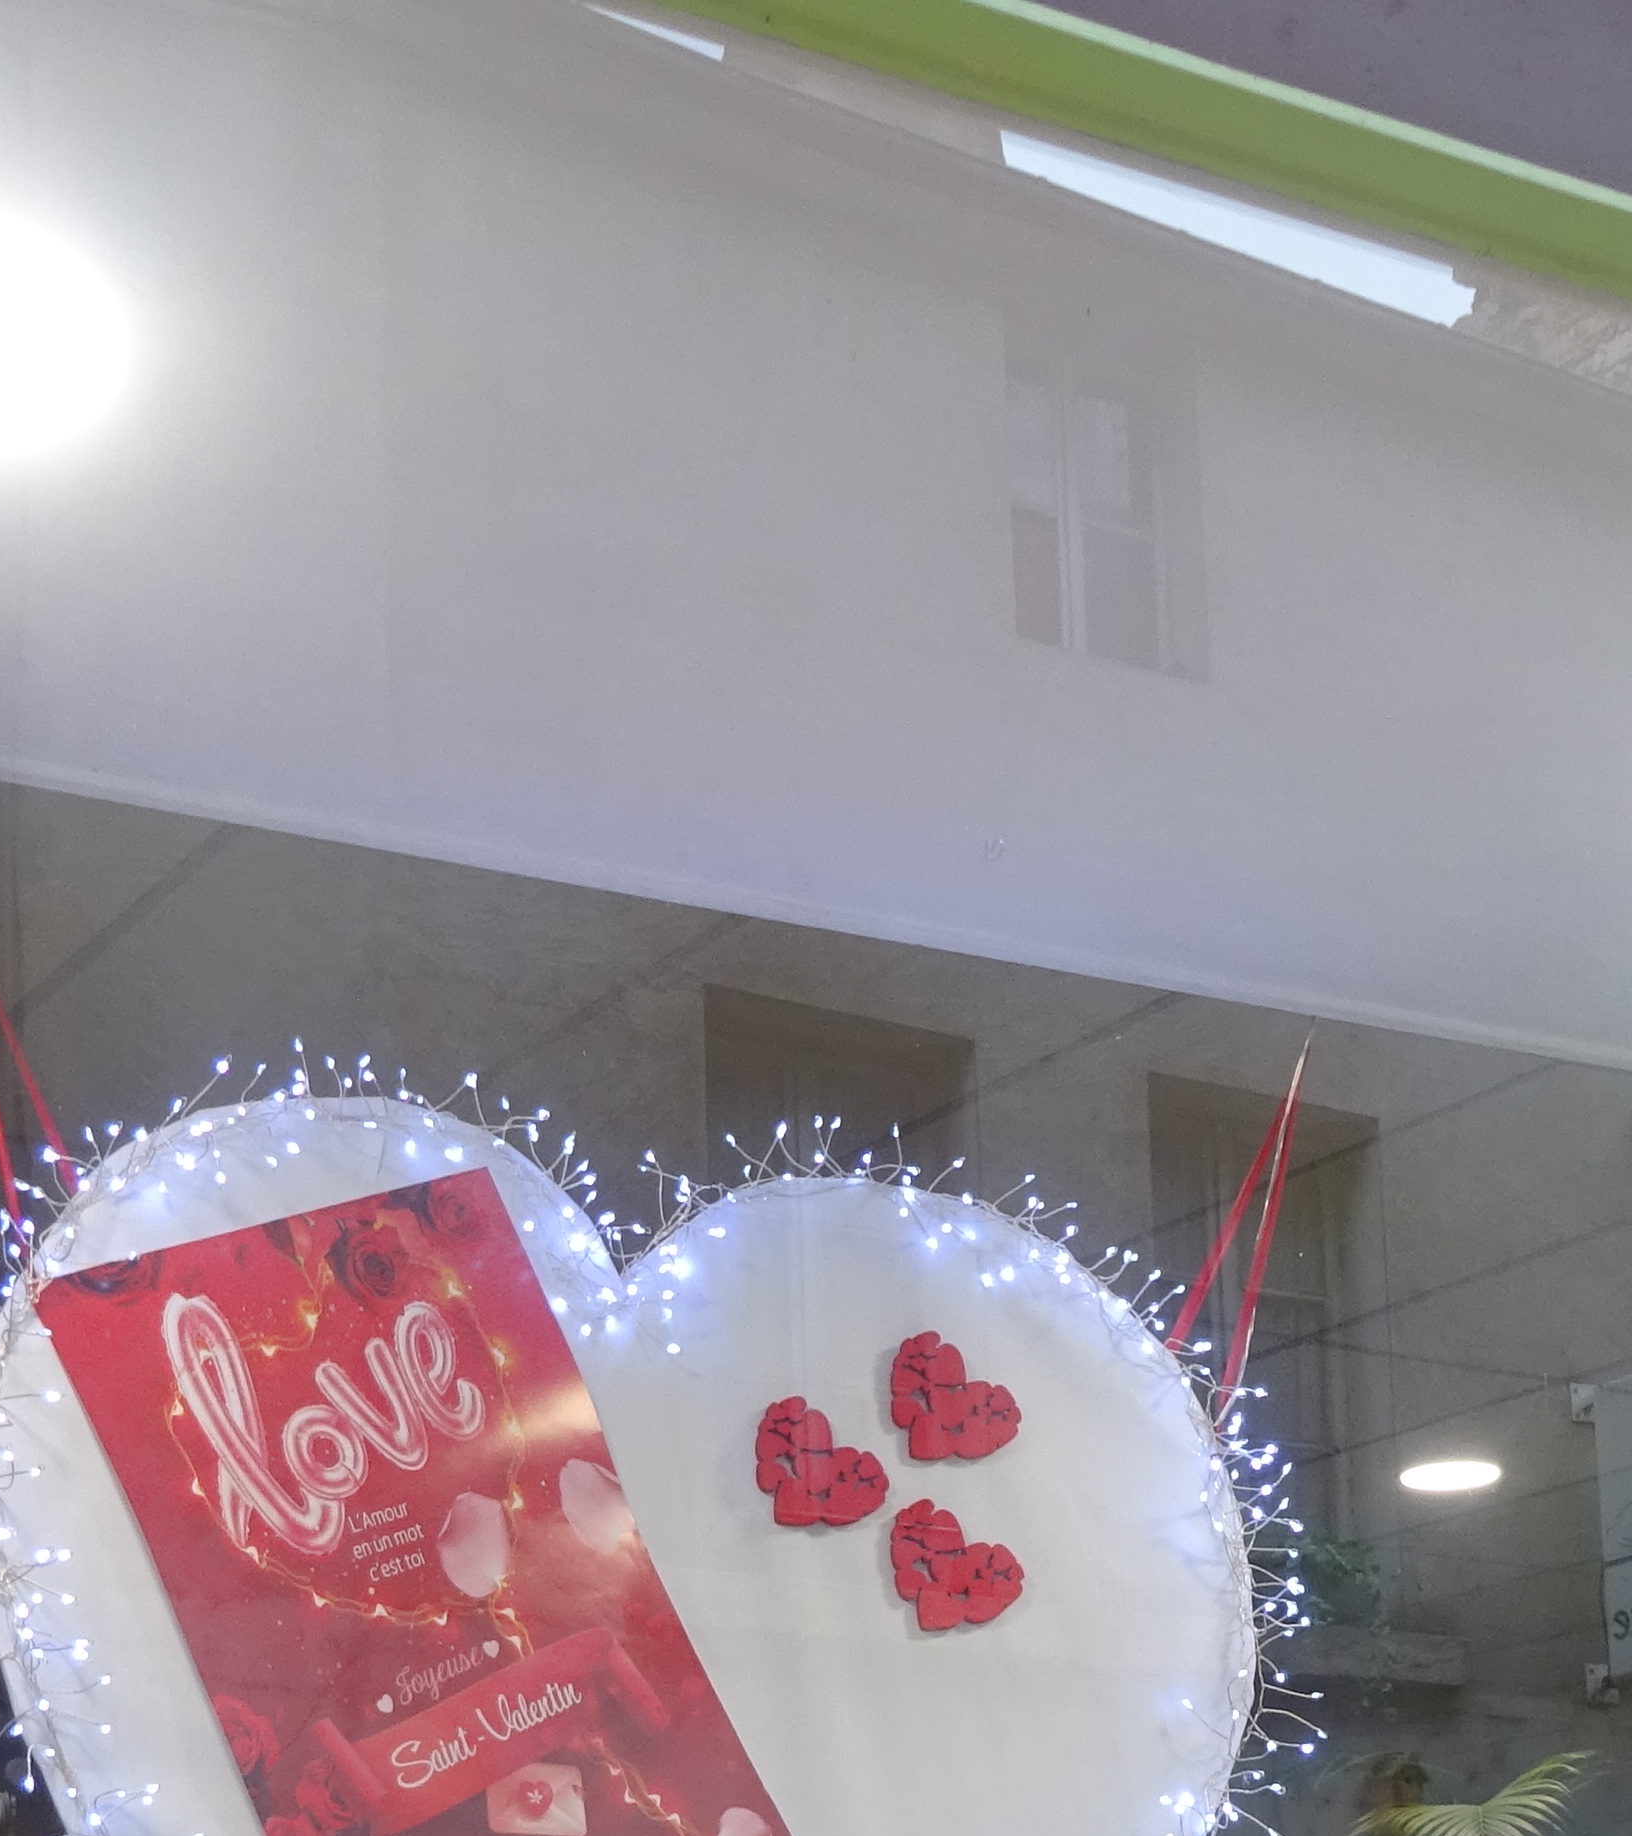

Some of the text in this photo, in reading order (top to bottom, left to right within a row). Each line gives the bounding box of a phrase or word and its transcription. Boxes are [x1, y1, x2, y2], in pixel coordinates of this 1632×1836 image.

[161, 1293, 485, 1556] love
[348, 1502, 408, 1533] L'Amour
[353, 1523, 424, 1559] en un mot
[369, 1548, 425, 1581] c'est toi
[396, 1646, 483, 1705] Joyeuse
